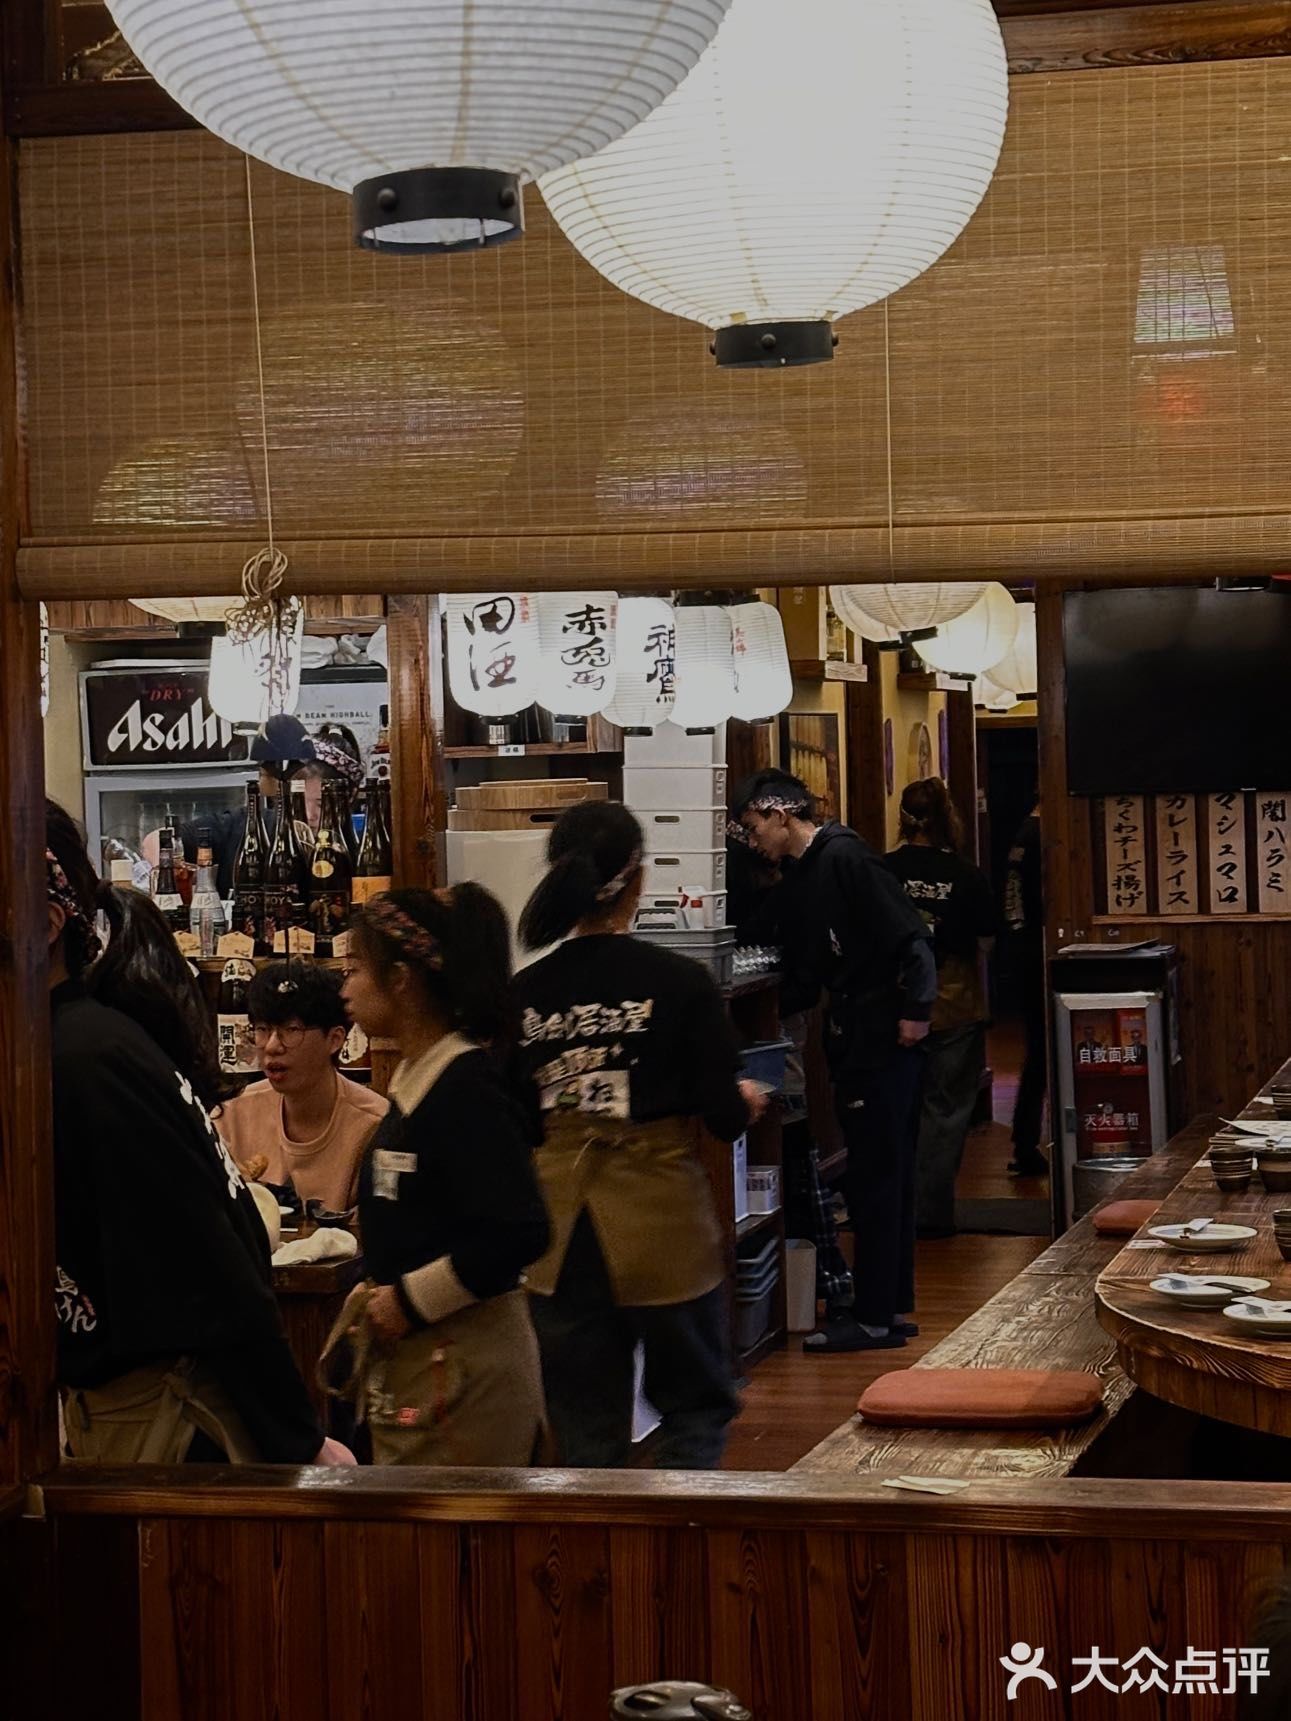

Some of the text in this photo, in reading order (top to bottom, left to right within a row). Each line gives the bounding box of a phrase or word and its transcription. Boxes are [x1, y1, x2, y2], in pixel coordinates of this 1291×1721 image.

[463, 597, 518, 691] 田酒
[107, 697, 232, 752] Asahi
[1166, 796, 1190, 905] カレーライス
[1205, 792, 1239, 903] マシュマロ
[220, 1025, 238, 1066] 開運
[1079, 1046, 1138, 1064] 自救面具
[1084, 1112, 1140, 1127] 灭火器箱
